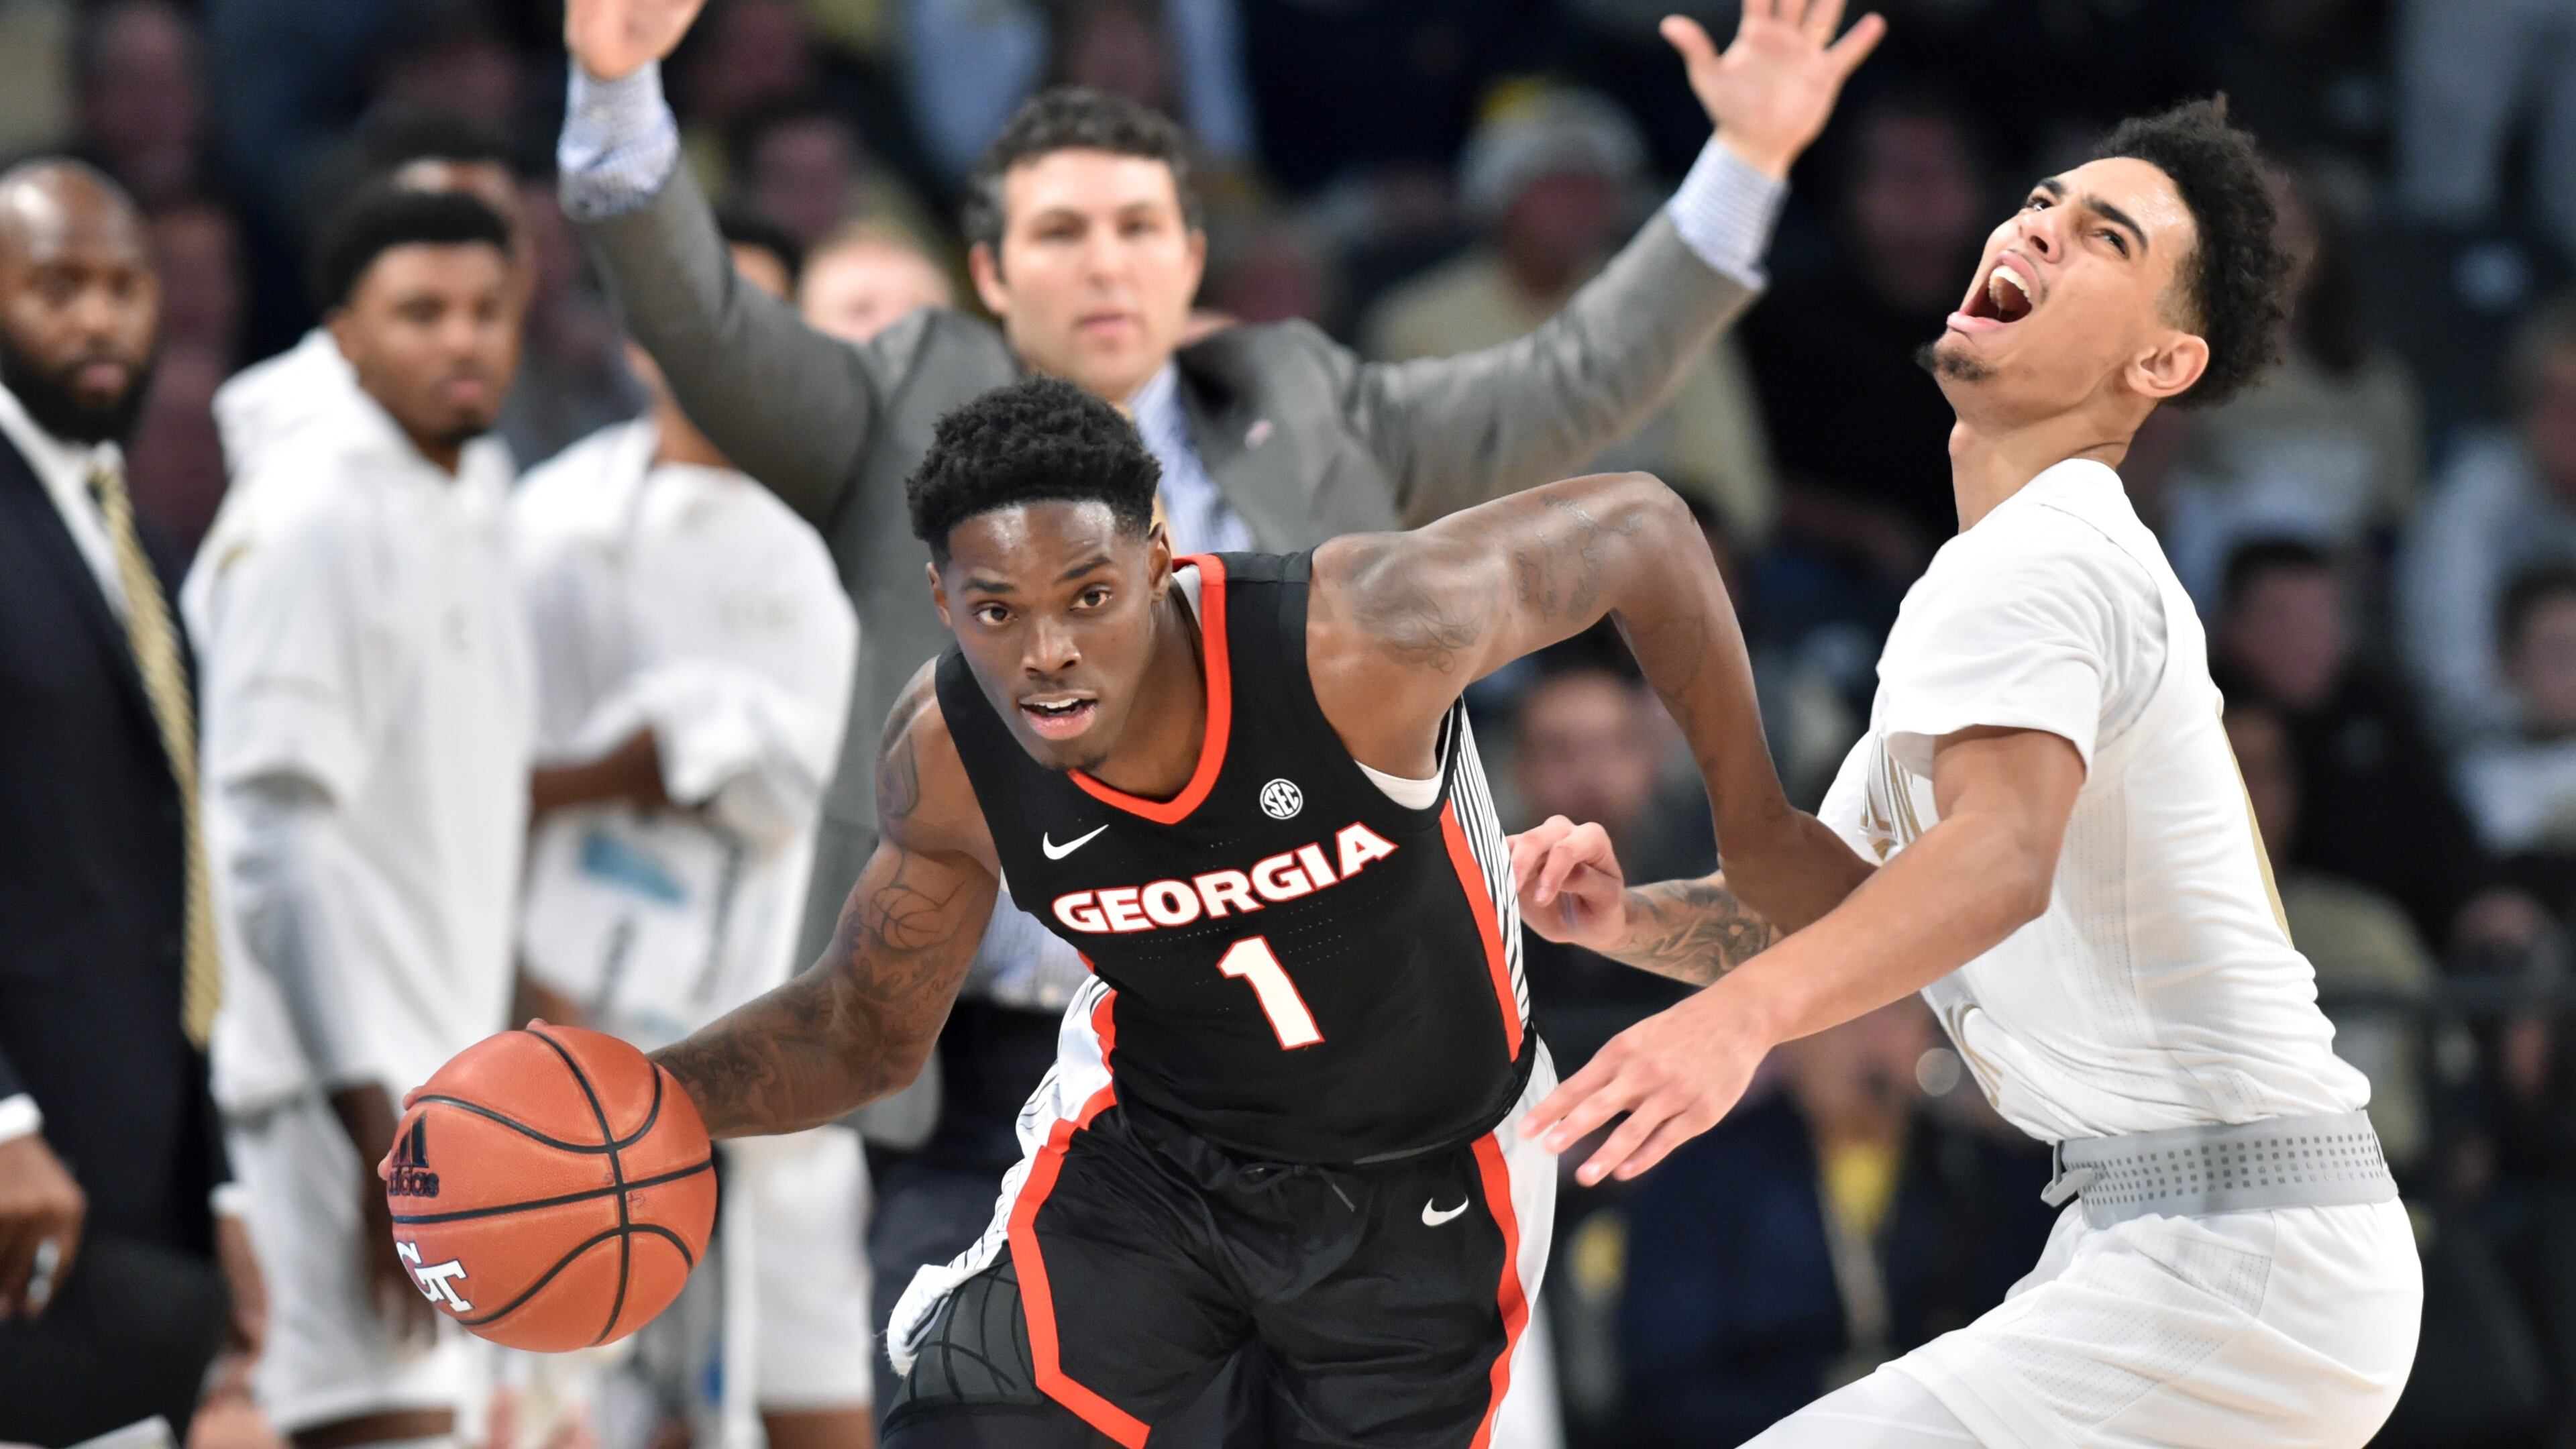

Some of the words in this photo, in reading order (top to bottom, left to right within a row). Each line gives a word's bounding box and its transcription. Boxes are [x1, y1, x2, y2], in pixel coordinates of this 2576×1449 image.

[1263, 782, 1300, 817] SEC
[1053, 822, 1398, 932] GEORGIA
[1217, 936, 1324, 1049] 1
